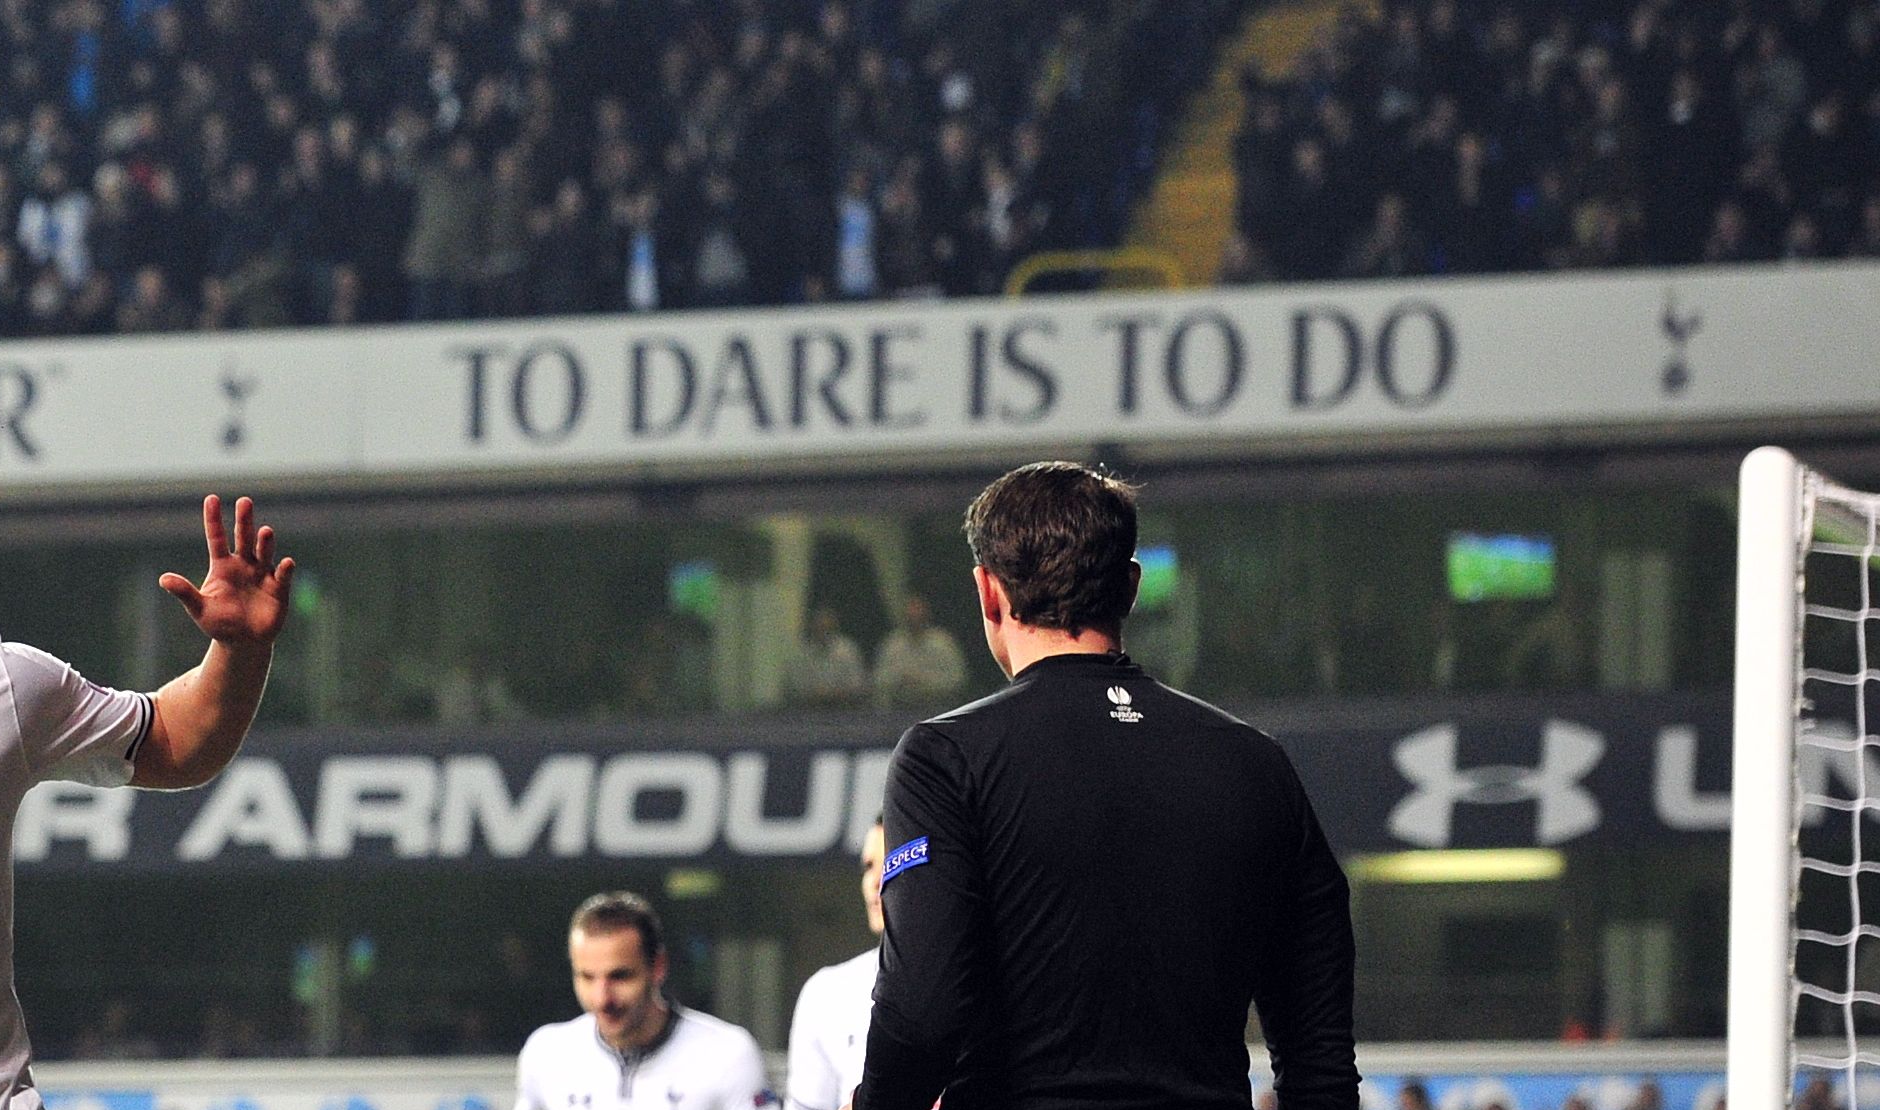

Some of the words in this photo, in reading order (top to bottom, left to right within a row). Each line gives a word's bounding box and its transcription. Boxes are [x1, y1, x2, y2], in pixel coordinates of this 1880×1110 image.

[442, 336, 586, 447] TO
[626, 322, 928, 442] DARE
[966, 314, 1058, 424] IS
[1095, 304, 1247, 418] TO
[1290, 297, 1458, 412] DO
